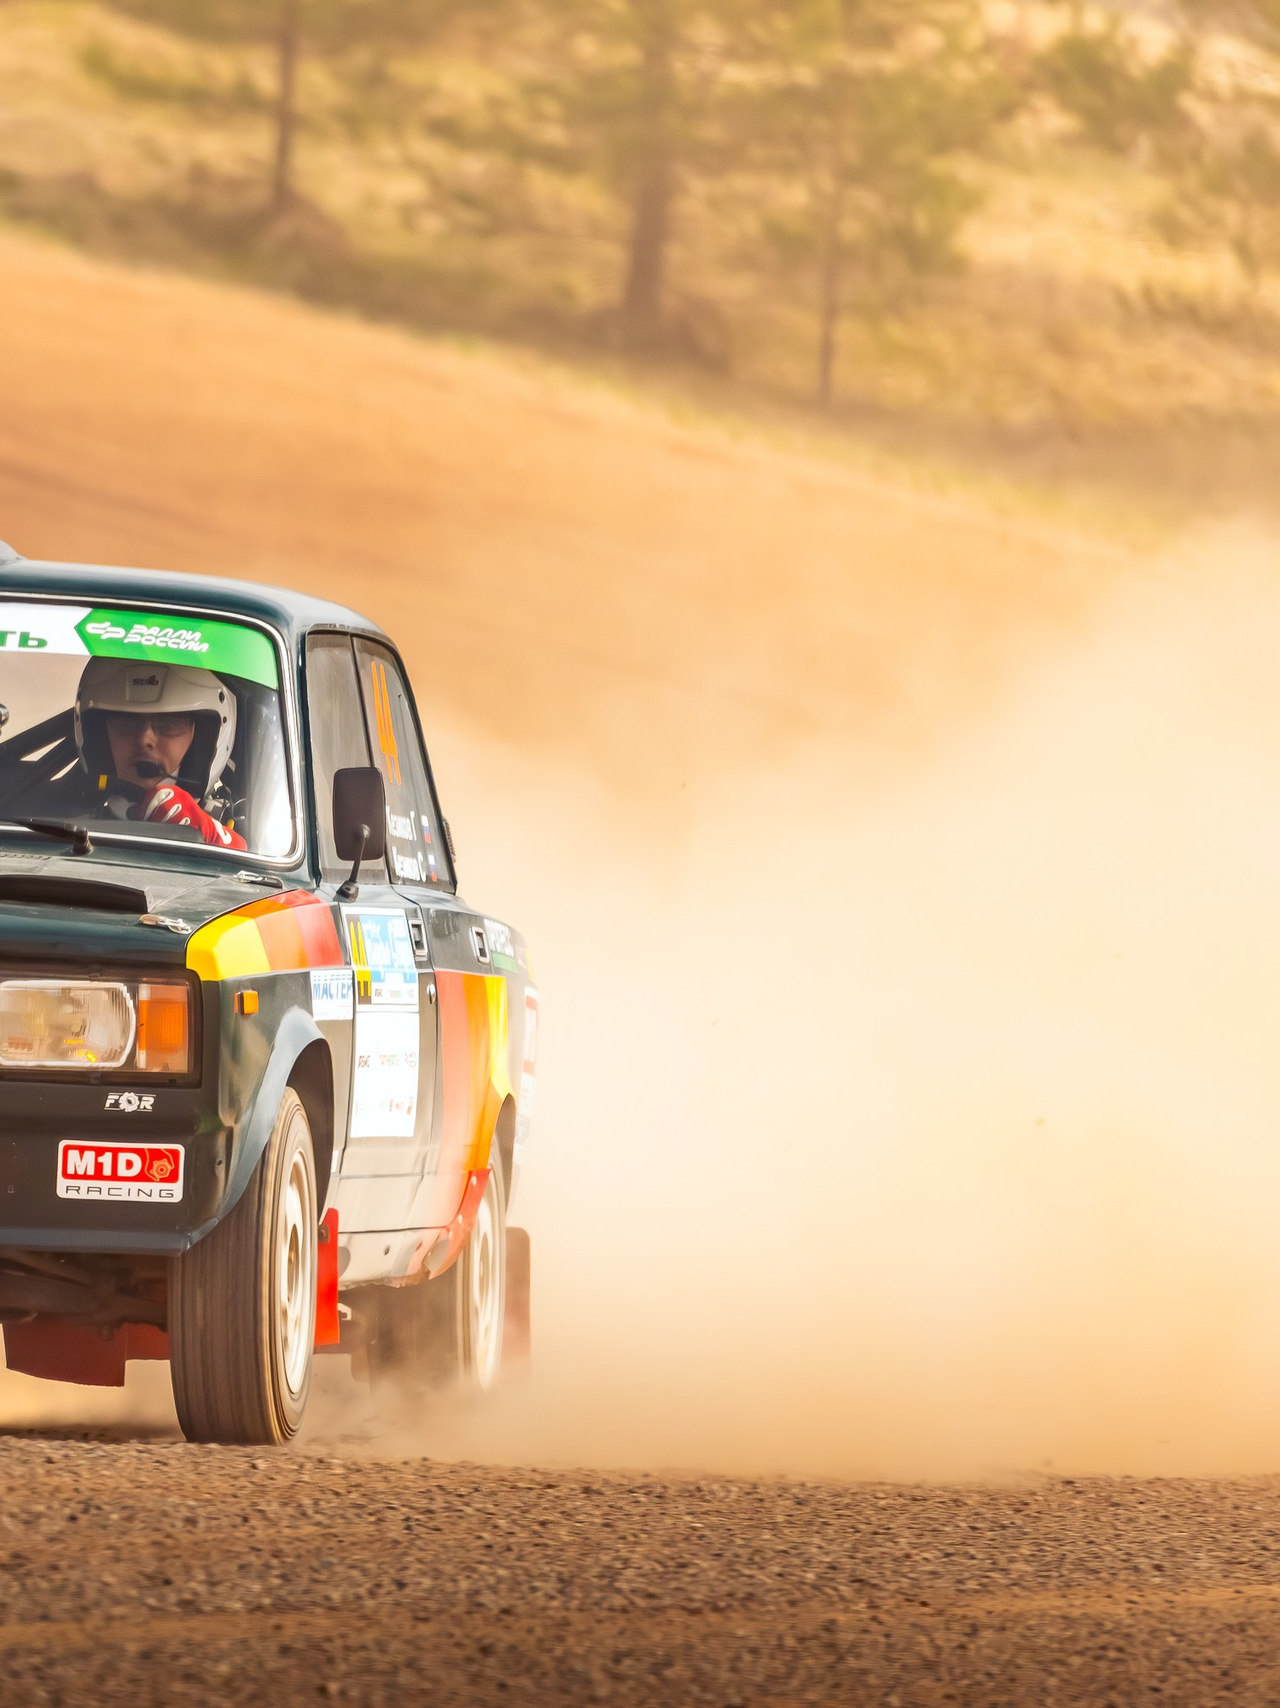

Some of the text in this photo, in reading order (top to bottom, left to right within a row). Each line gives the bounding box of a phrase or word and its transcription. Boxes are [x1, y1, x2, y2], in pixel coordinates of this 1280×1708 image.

[130, 624, 202, 642] РАЛЛИ
[123, 633, 210, 653] РОССИИ
[66, 1149, 143, 1178] M1D
[65, 1185, 174, 1199] RACING
